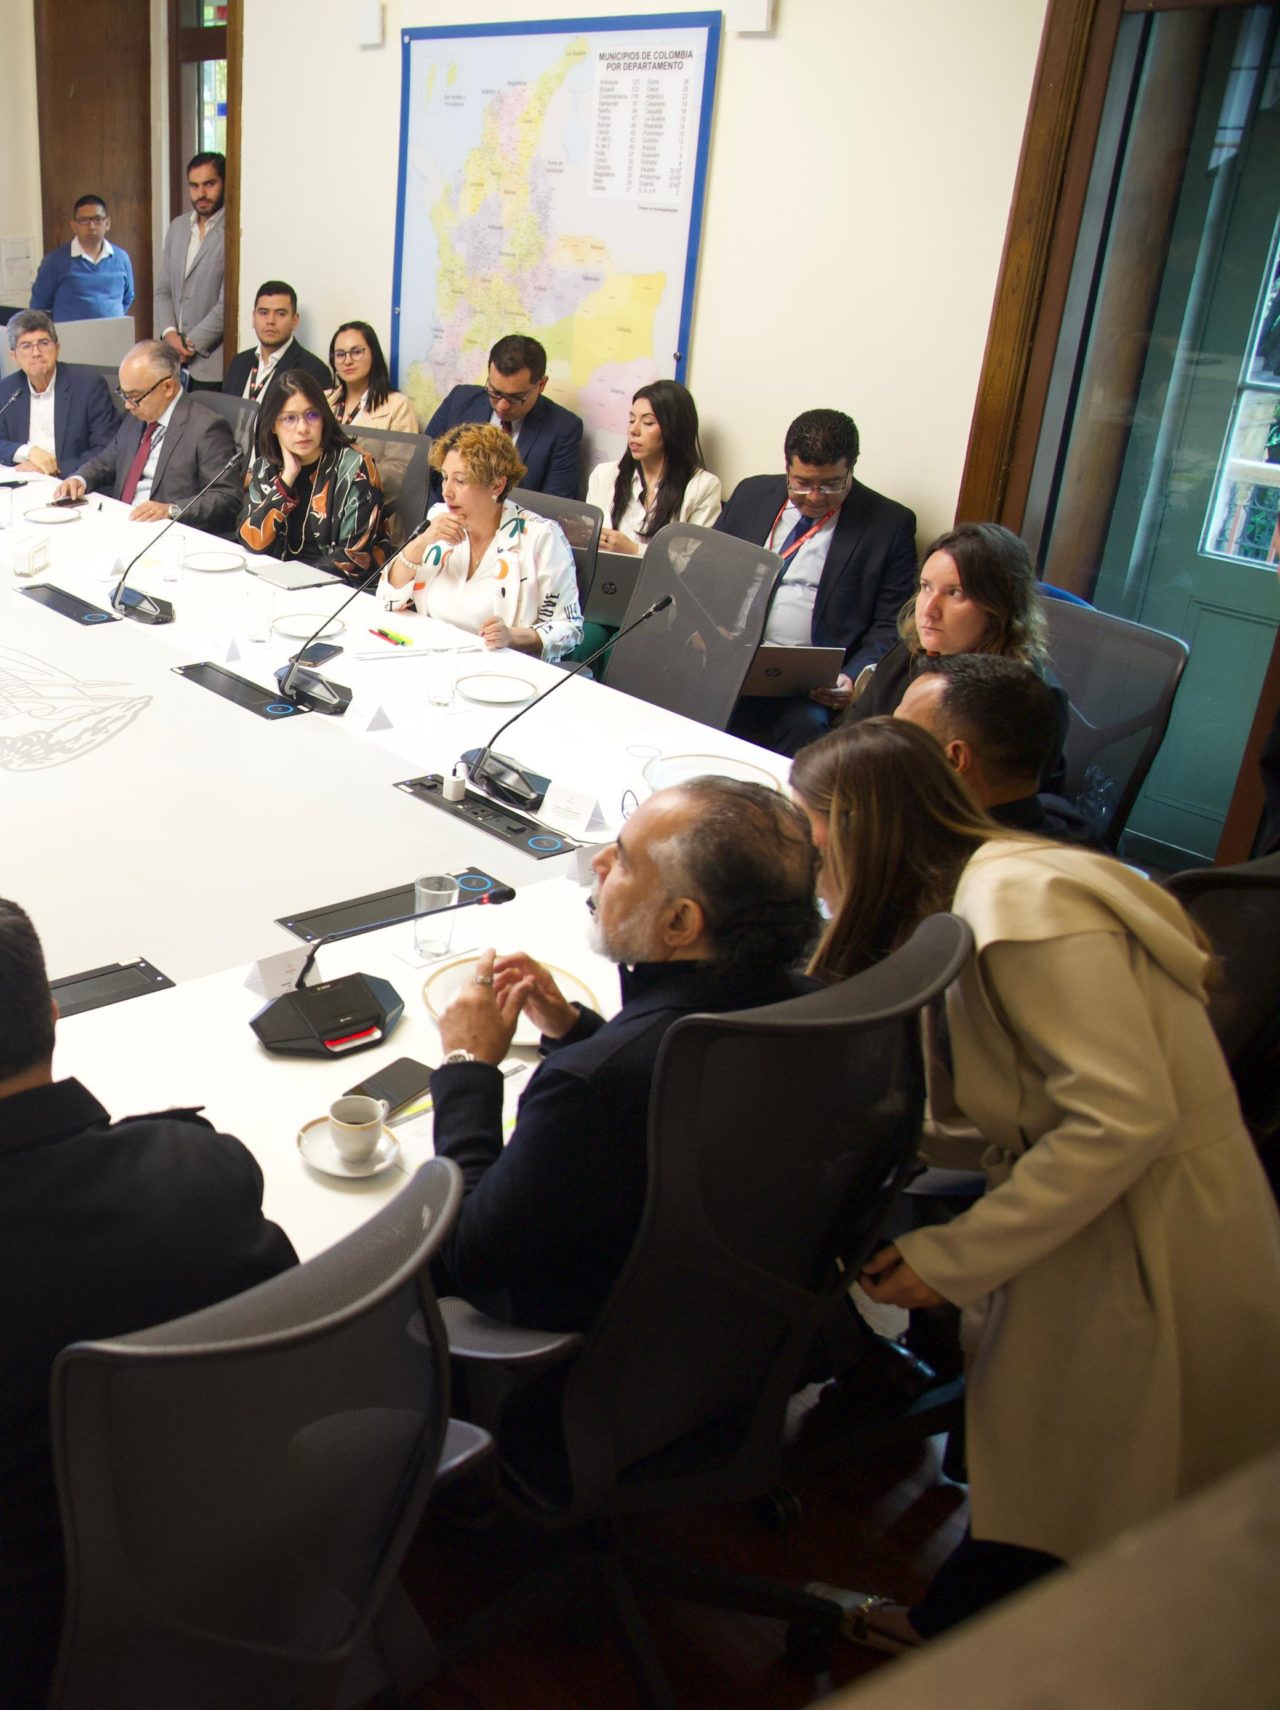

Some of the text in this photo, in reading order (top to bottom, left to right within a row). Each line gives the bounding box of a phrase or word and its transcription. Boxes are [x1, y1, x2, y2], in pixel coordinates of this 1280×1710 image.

[599, 50, 694, 61] MUNICIPIOS DE COLOMBIA
[606, 61, 684, 71] POR DEPARTAMENTO
